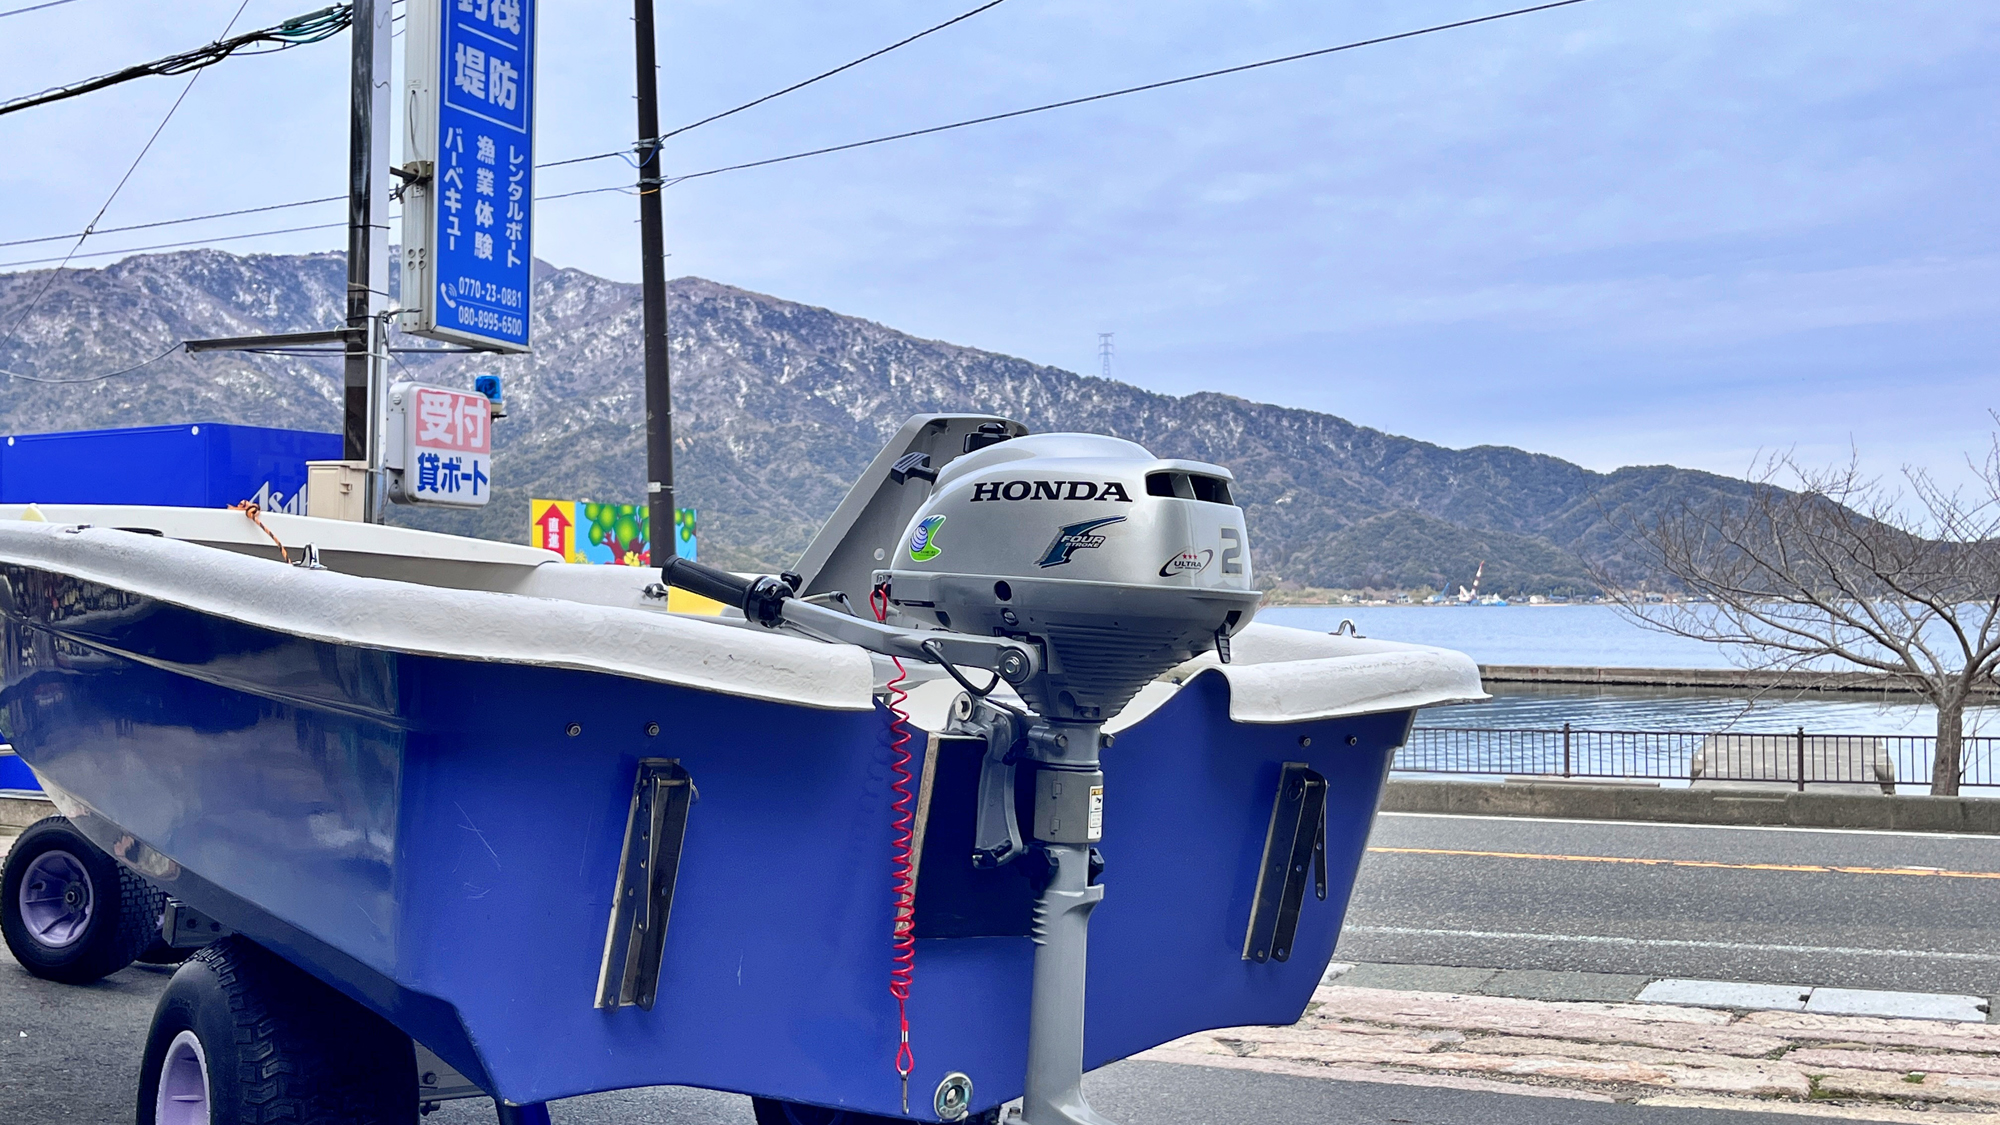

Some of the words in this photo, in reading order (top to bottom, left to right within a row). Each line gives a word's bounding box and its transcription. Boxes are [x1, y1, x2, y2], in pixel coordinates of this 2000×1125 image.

[454, 42, 519, 111] 堤防
[444, 127, 463, 251] バーベキュー
[474, 134, 495, 261] 漁業体験
[505, 145, 524, 268] レンタルボート
[458, 276, 522, 308] 0770-23-0881
[458, 305, 522, 336] 080-8995-6500
[419, 391, 487, 448] 受付
[417, 452, 488, 496] 貸ボート
[970, 480, 1133, 502] HONDA
[548, 517, 560, 549] 直進
[1061, 535, 1105, 543] FOUR
[1220, 527, 1243, 575] 2
